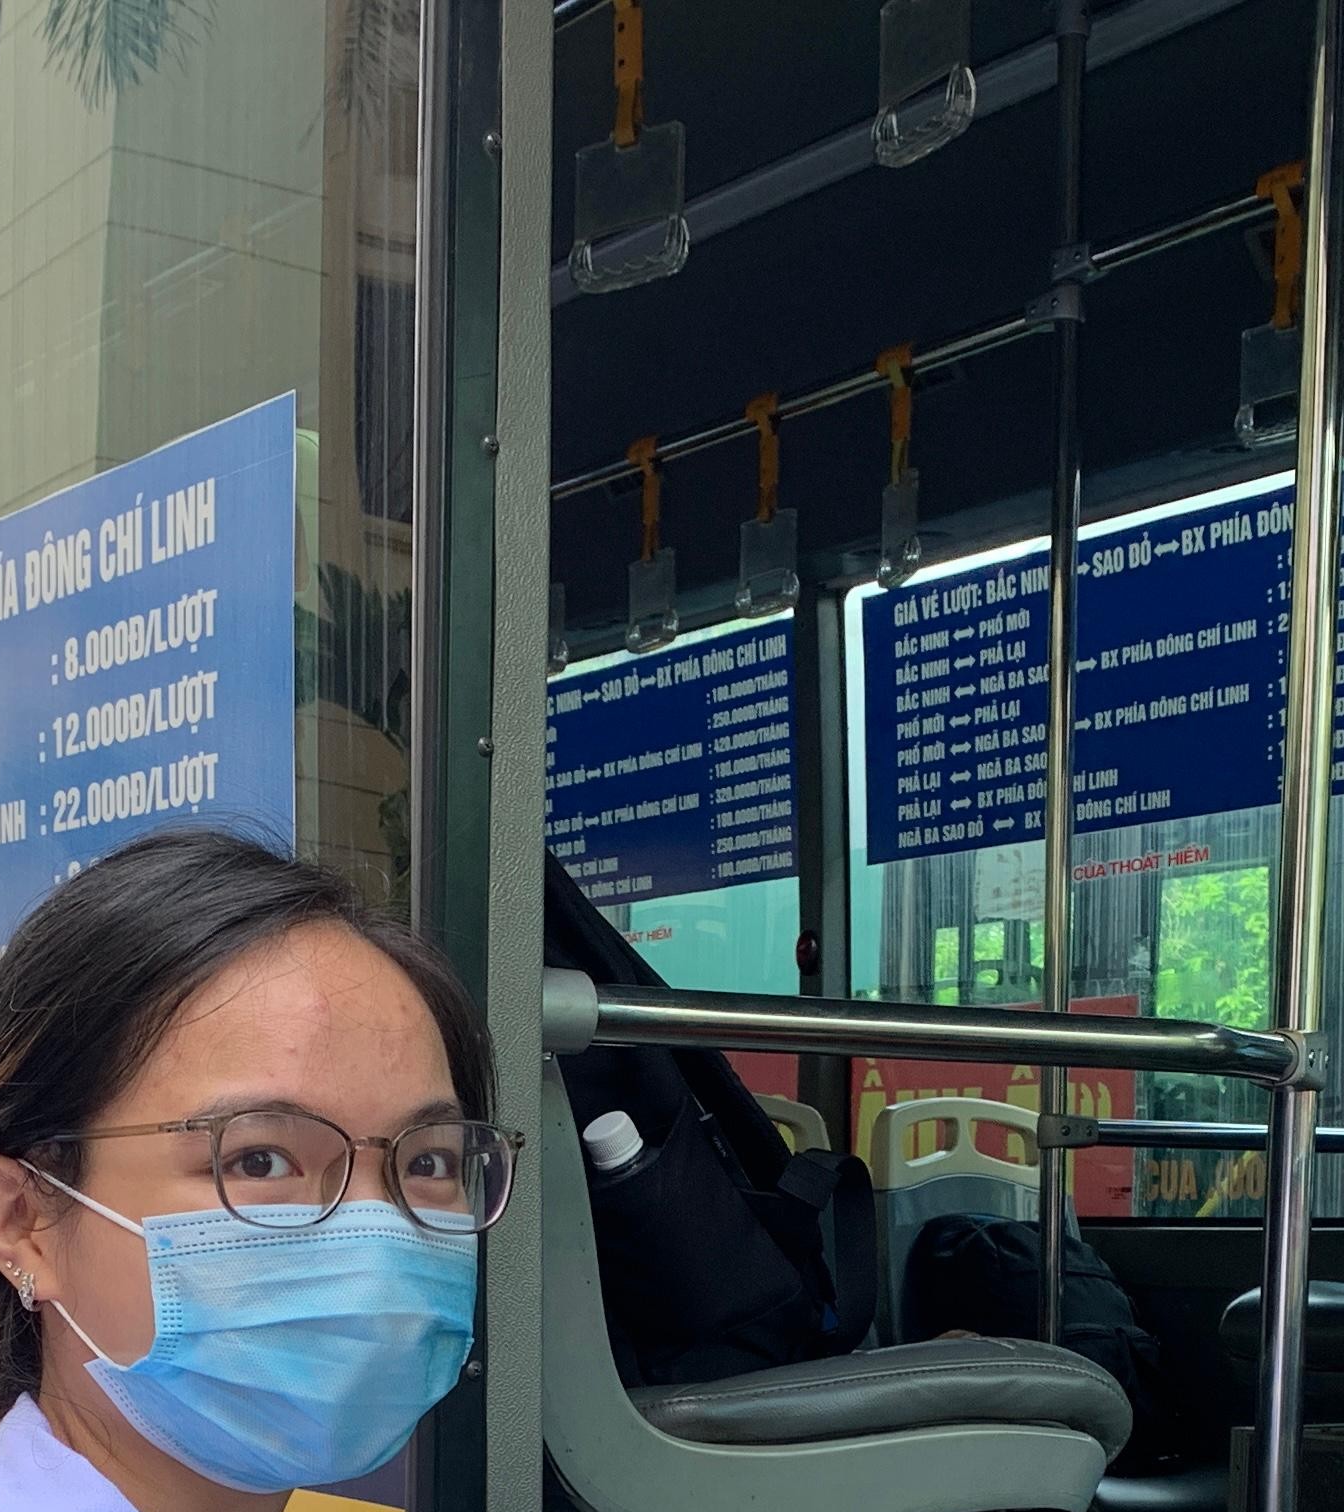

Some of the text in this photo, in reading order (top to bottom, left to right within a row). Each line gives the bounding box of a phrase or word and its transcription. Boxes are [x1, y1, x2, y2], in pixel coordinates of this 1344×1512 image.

[25, 530, 91, 611] ĐÔNG
[99, 492, 143, 582] CHÍ
[151, 477, 215, 564] LINH
[894, 595, 919, 627] GIÁ
[921, 589, 940, 620] VÉ
[1020, 565, 1051, 597] NIN
[1092, 547, 1124, 578] SAO
[1128, 531, 1152, 569] ĐỎ
[1181, 526, 1206, 556] BX
[1209, 511, 1253, 549] PHÍA
[1256, 501, 1295, 538] ĐÔN
[64, 589, 217, 680] 8.000Đ/LƯỢT
[656, 665, 672, 688] BX
[674, 654, 701, 684] PHÍA
[920, 630, 949, 652] NINH
[979, 610, 1003, 639] PHỐ
[922, 685, 950, 709] NINH
[1008, 669, 1024, 690] BA
[1100, 651, 1119, 670] BX
[1122, 639, 1153, 665] PHÍA
[1156, 633, 1194, 659] ĐÔNG
[1197, 623, 1221, 651] CHÍ
[1224, 619, 1257, 645] LINH
[53, 670, 218, 758] 12.000Đ/LƯỢT
[1002, 728, 1019, 748] BA
[1021, 723, 1046, 744] SAO
[1094, 711, 1113, 731] BX
[1115, 701, 1147, 727] PHÍA
[1149, 695, 1187, 719] ĐÔNG
[1190, 687, 1214, 712] CHÍ
[1217, 683, 1249, 707] LINH
[53, 752, 218, 833] 22.000Đ/LƯỢT
[924, 825, 940, 844] BA
[942, 822, 965, 842] SAO
[1024, 810, 1041, 830] BX
[1115, 791, 1137, 814] CHÍ
[1140, 789, 1171, 811] LINH
[977, 768, 1118, 809] BX PHÍA LINH
